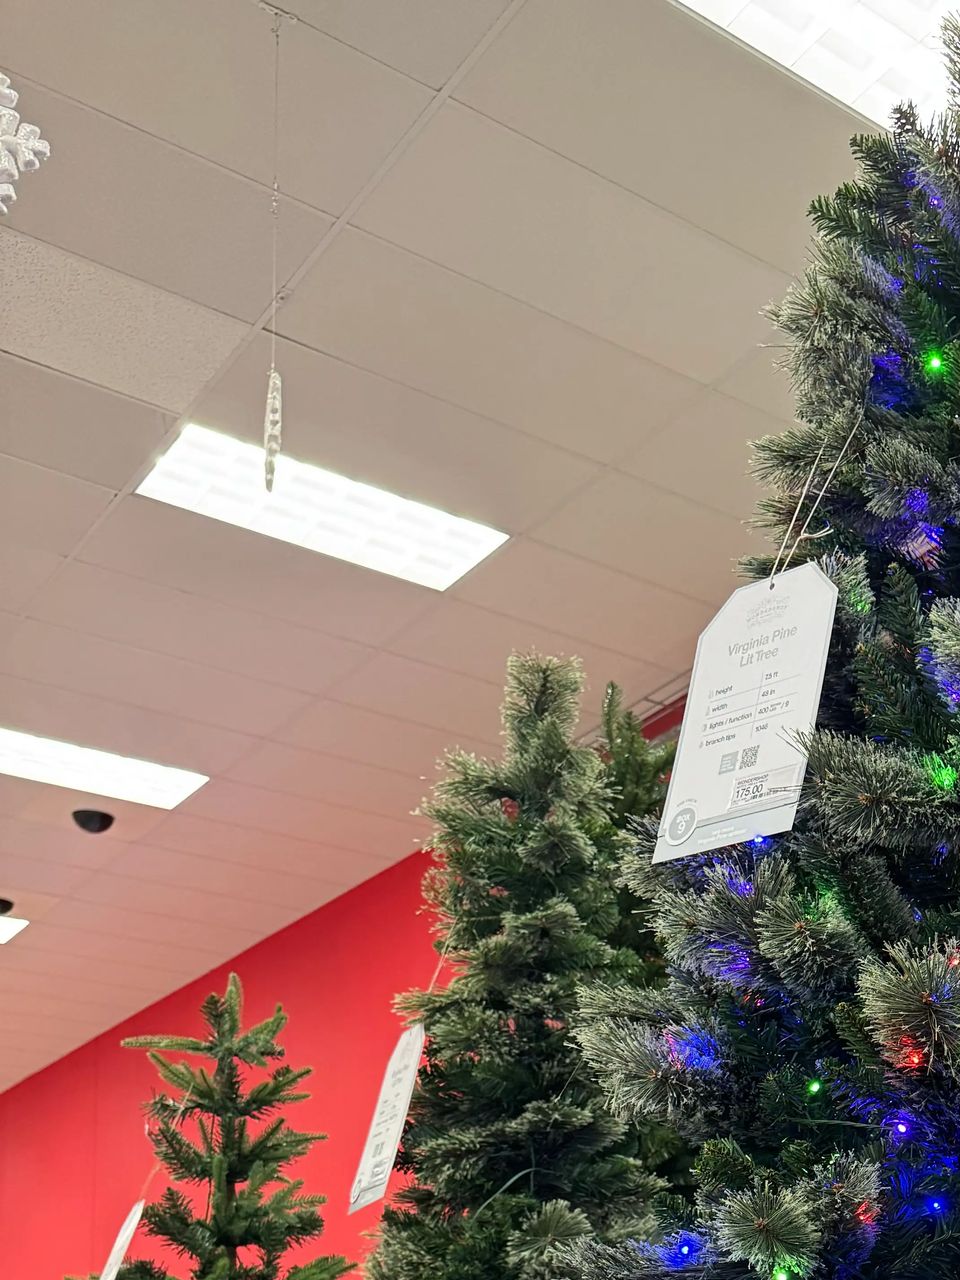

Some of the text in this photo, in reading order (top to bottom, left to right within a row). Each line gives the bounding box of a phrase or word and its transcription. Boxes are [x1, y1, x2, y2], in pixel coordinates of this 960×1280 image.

[728, 626, 798, 656] Virginia Pine
[740, 647, 779, 667] Lit Tree
[714, 685, 733, 696] height
[711, 703, 728, 712] width
[728, 712, 752, 724] function
[705, 735, 725, 746] branch
[737, 773, 769, 785] WONDERSHOP
[736, 783, 763, 799] 175.00
